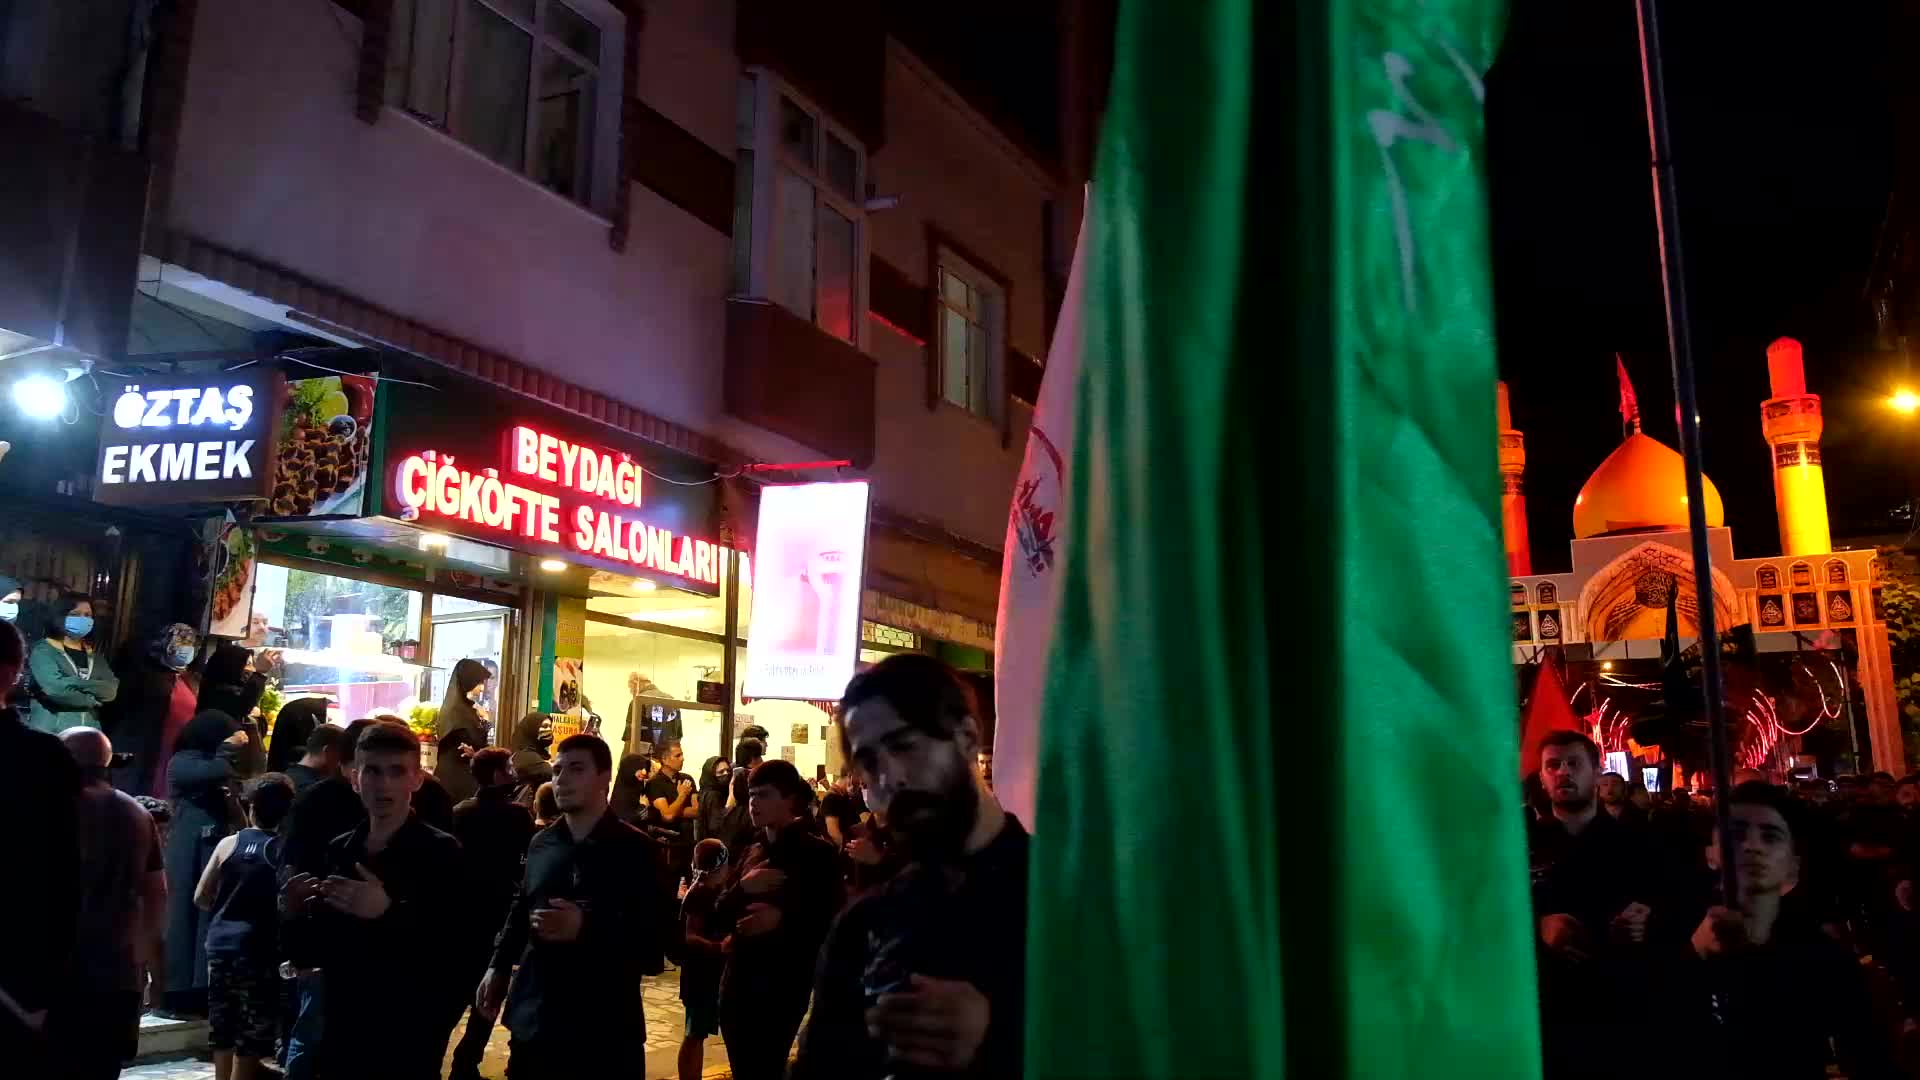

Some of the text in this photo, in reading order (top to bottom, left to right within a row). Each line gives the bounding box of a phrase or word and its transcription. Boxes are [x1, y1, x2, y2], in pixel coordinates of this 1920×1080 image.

[112, 384, 254, 431] ÖZTAŞ
[102, 439, 256, 484] EKMEK
[513, 425, 643, 508] BEYDAĞI
[397, 450, 719, 584] ÇİĞKÖFTE SALONLARI
